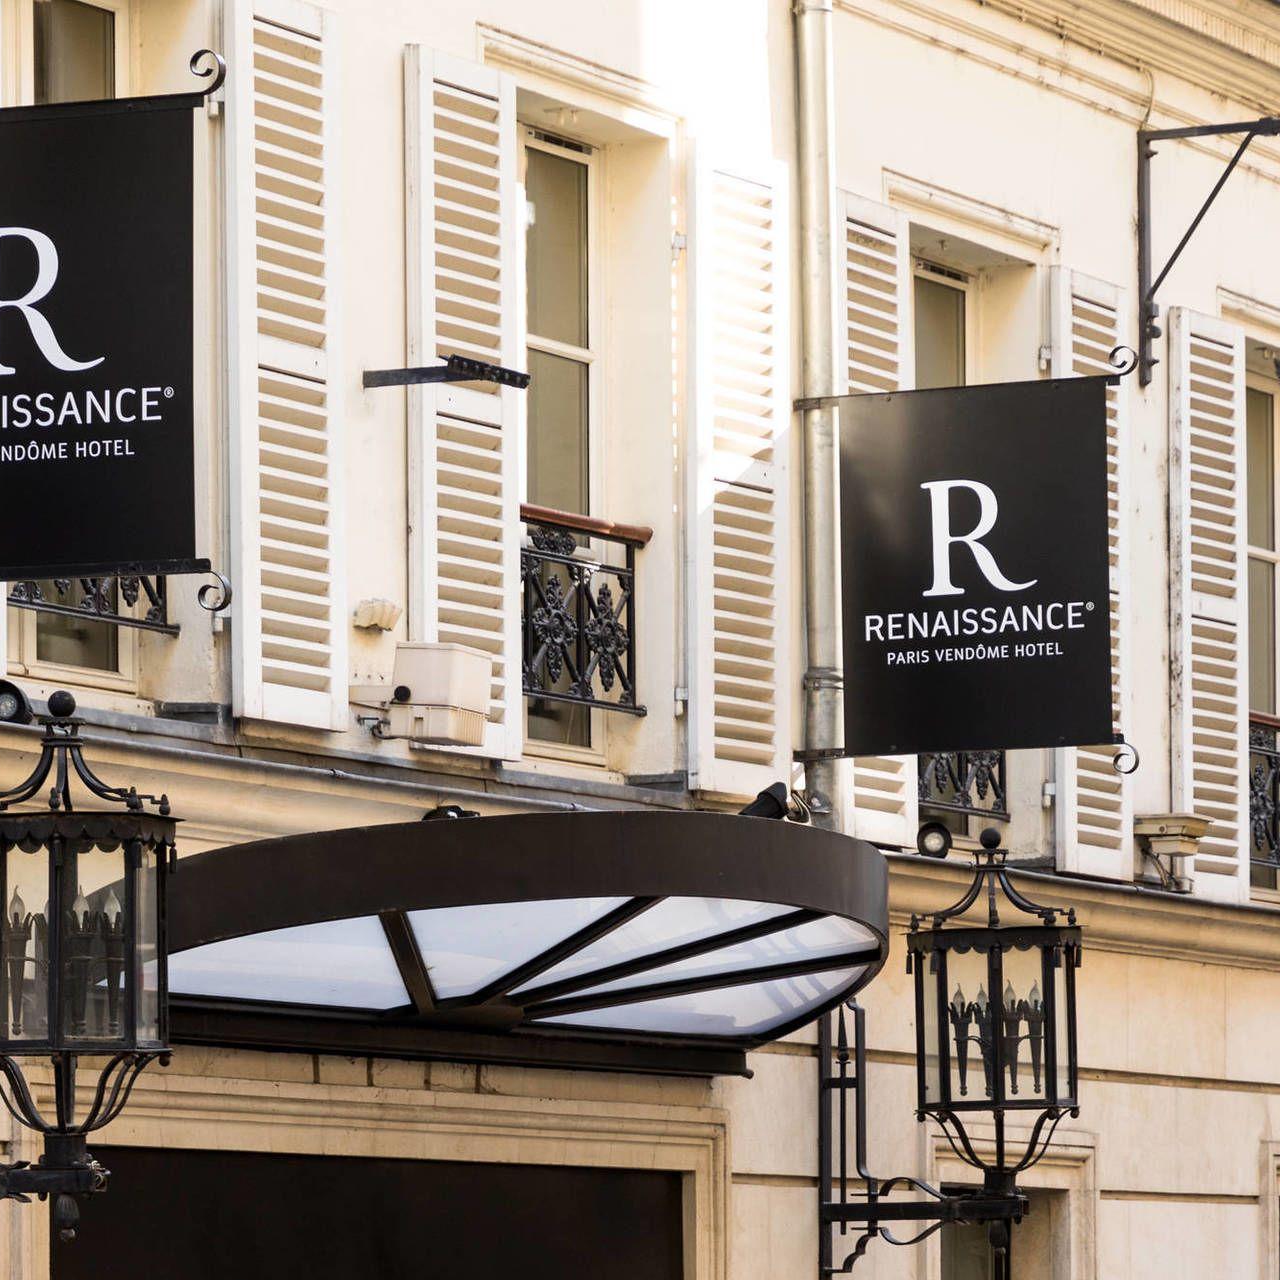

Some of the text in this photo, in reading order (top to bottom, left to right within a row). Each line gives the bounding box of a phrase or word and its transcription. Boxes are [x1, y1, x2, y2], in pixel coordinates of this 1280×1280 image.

[75, 439, 135, 458] HOTEL
[919, 479, 1038, 597] R
[887, 642, 1064, 665] PARIS VENDÔME HOTEL
